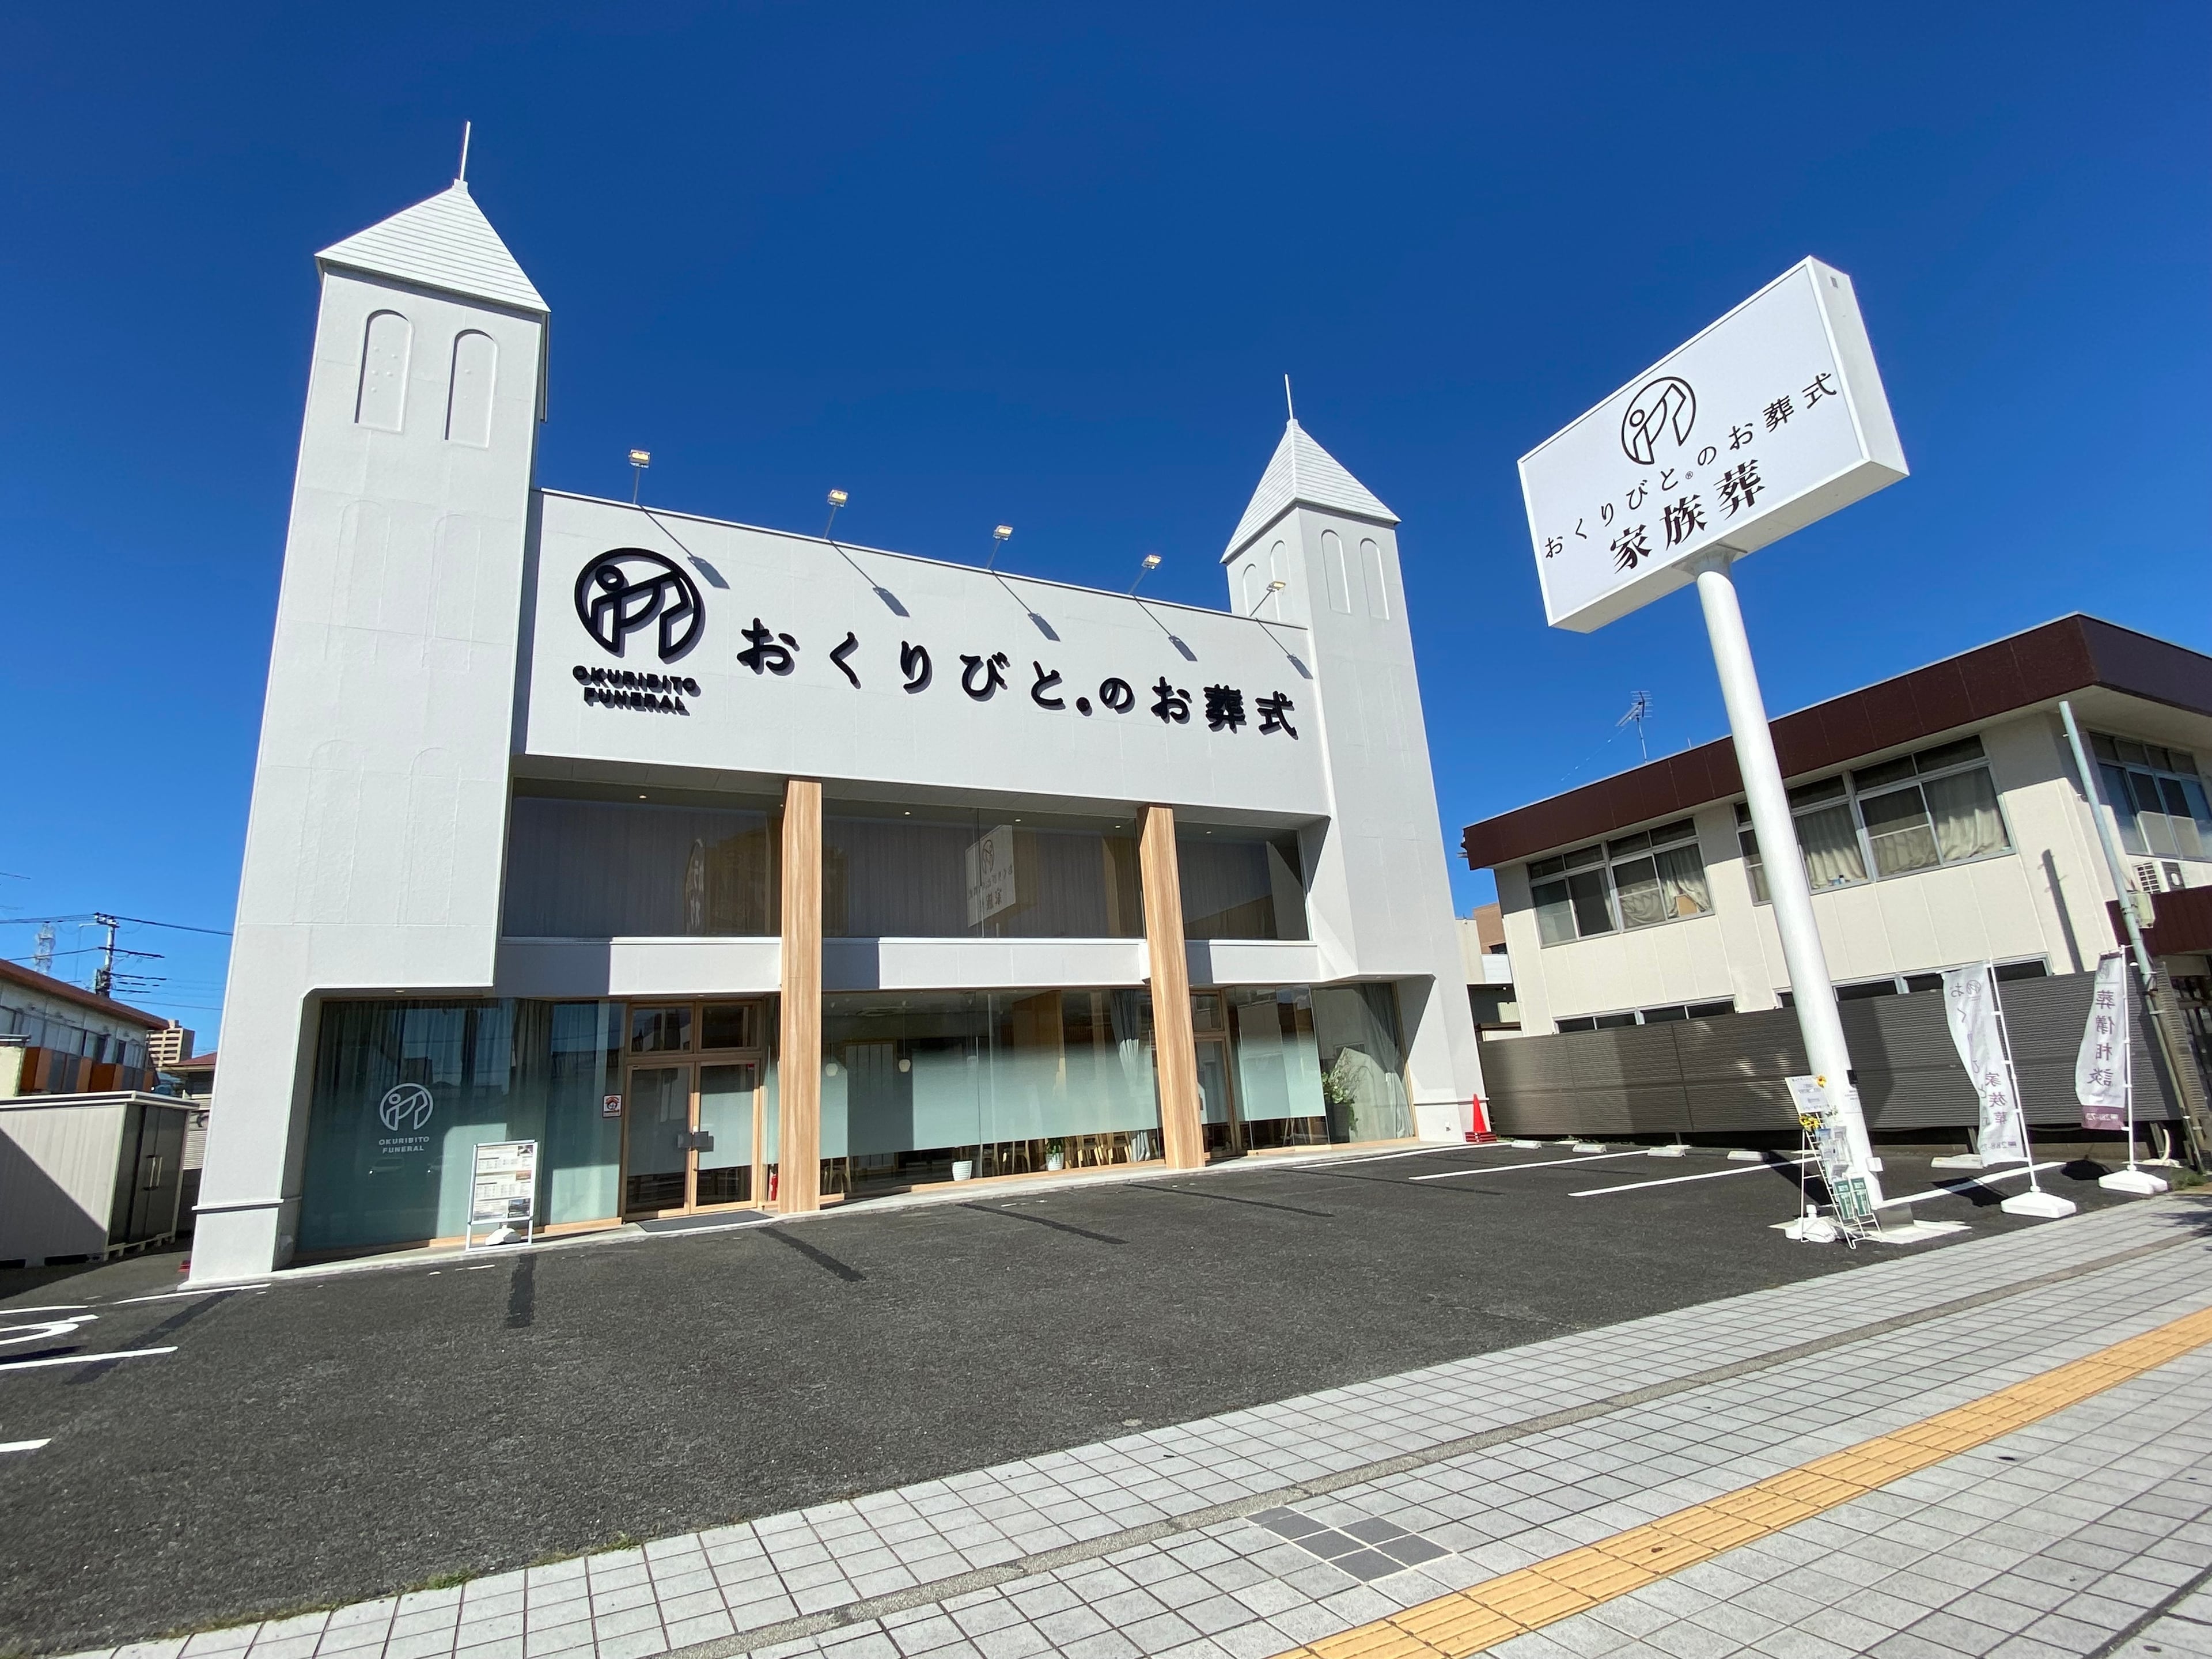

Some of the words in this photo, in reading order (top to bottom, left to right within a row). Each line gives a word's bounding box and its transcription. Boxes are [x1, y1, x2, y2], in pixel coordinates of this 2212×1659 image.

[1610, 459, 1766, 574] 家族葬
[573, 665, 698, 695] OKURIBITO
[584, 687, 687, 714] FUNERAL
[378, 1136, 429, 1145] OKURIBITO
[382, 1145, 424, 1154] FUNERAL
